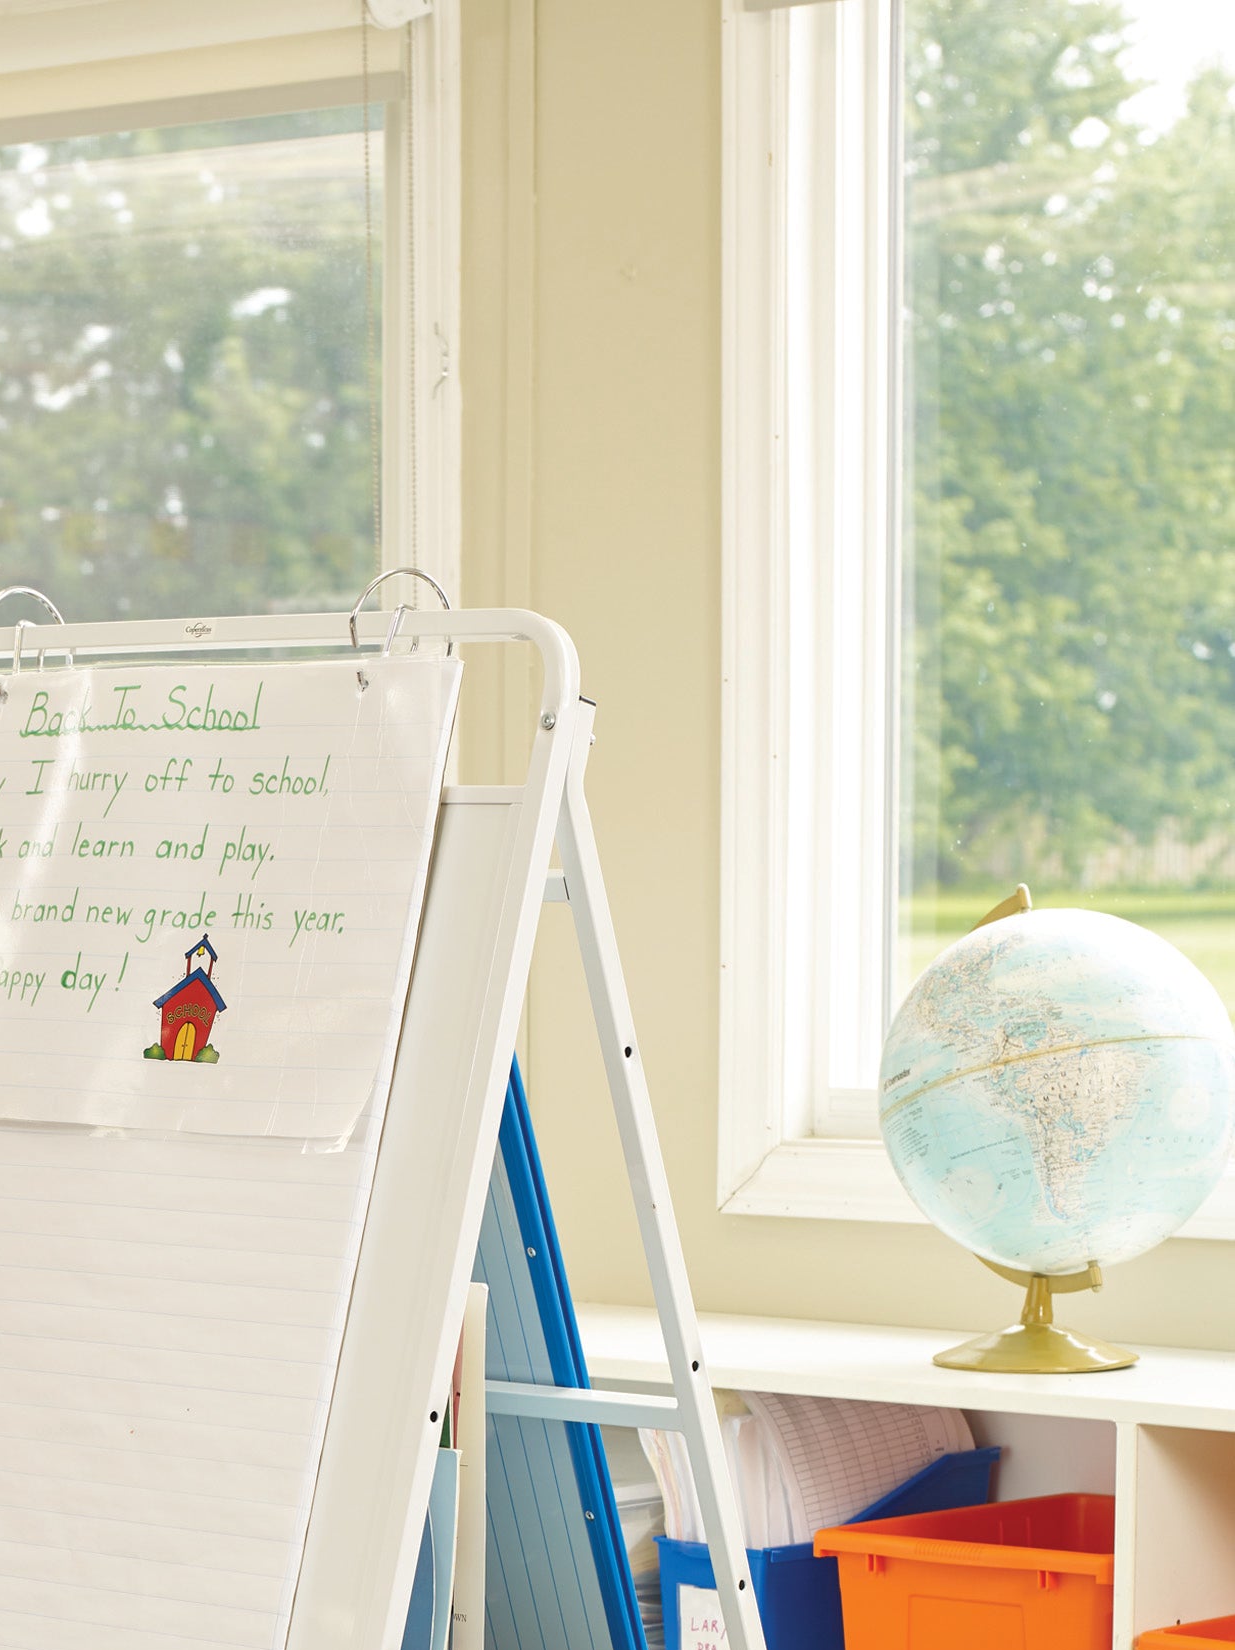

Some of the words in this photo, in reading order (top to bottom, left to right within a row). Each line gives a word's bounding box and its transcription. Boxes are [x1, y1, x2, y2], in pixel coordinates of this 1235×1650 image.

[20, 688, 92, 737] Back
[113, 683, 142, 731] To
[162, 680, 263, 732] School
[25, 759, 56, 795] I
[67, 757, 129, 819] hurry
[144, 757, 193, 793] off
[208, 757, 235, 793] to
[249, 754, 331, 797] school,
[17, 822, 60, 858] and
[70, 821, 135, 858] learn
[155, 823, 209, 861] and
[217, 824, 275, 881] play.
[11, 886, 80, 923] brand
[85, 904, 133, 926] new
[134, 890, 217, 943] grade
[231, 892, 274, 930] this
[288, 908, 346, 949] year.
[166, 1003, 212, 1027] SCHOOL
